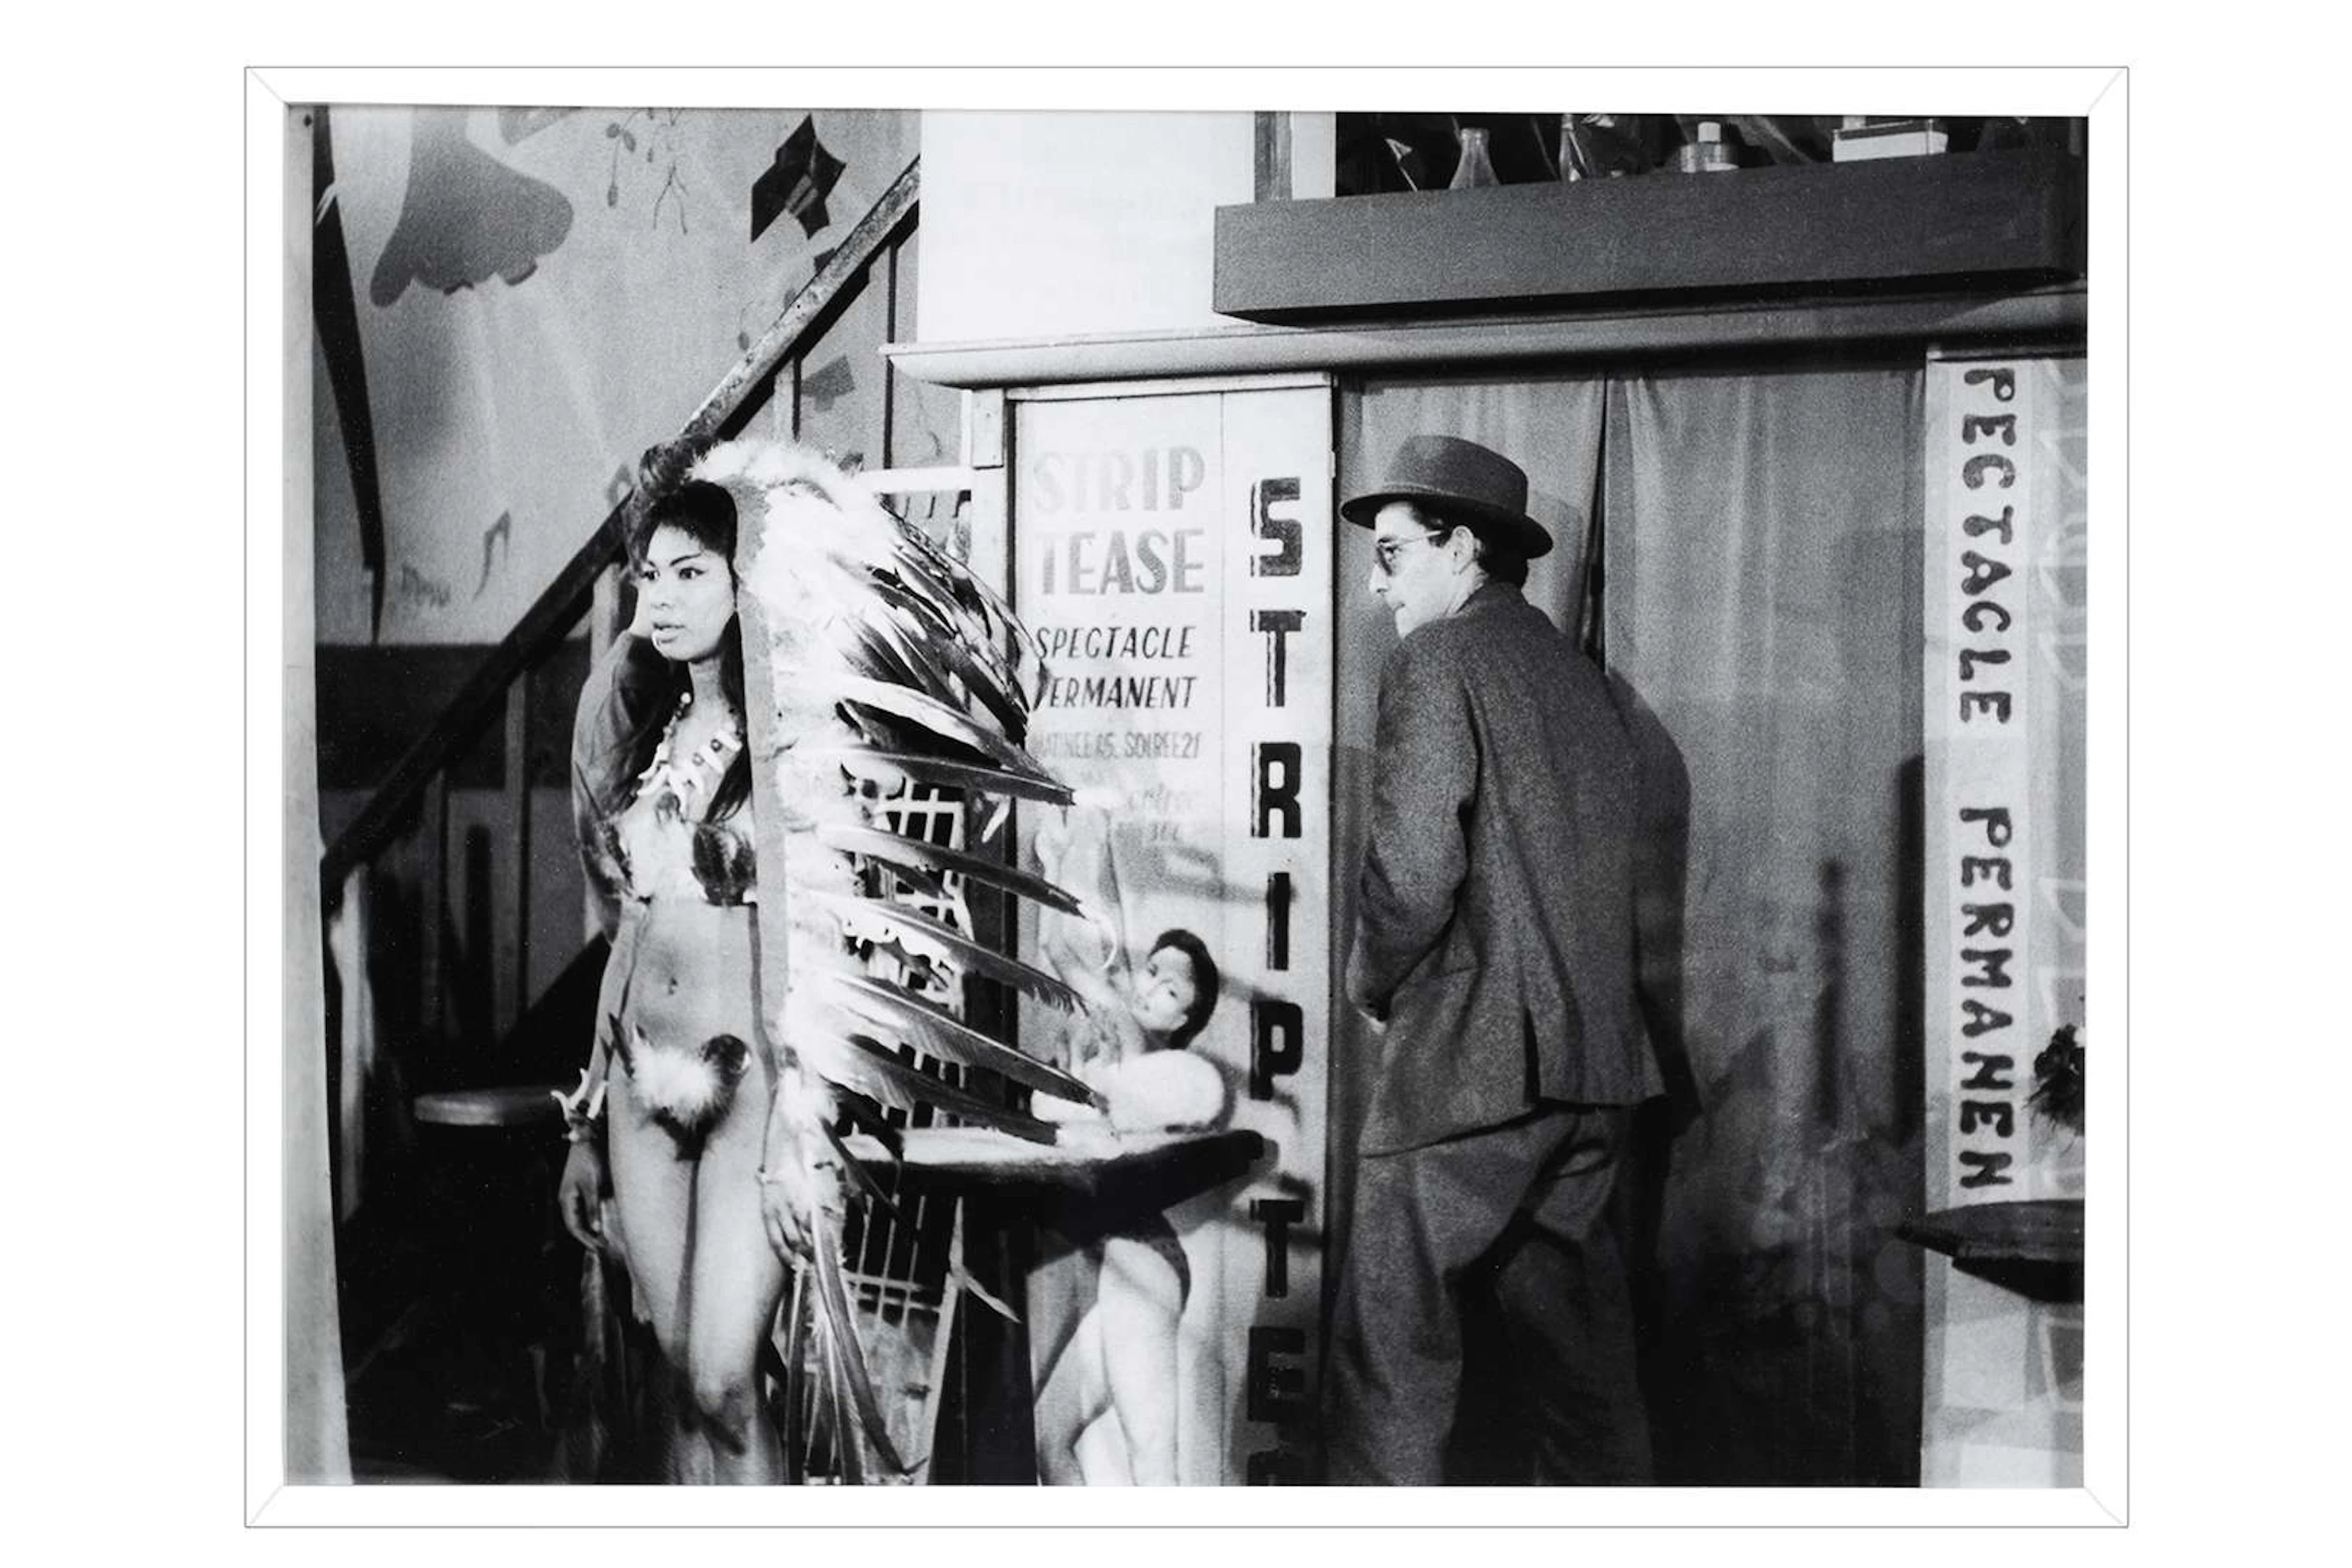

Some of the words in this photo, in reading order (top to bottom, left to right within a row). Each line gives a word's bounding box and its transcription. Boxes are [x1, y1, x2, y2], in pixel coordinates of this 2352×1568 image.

[1033, 446, 1206, 513] STRIP
[1034, 528, 1205, 595] TEASE
[1036, 625, 1197, 660] SPECTACLE
[1036, 675, 1197, 709] ERMANENT
[1249, 476, 1308, 1101] STRIP
[1960, 807, 2014, 1189] PERMANEN
